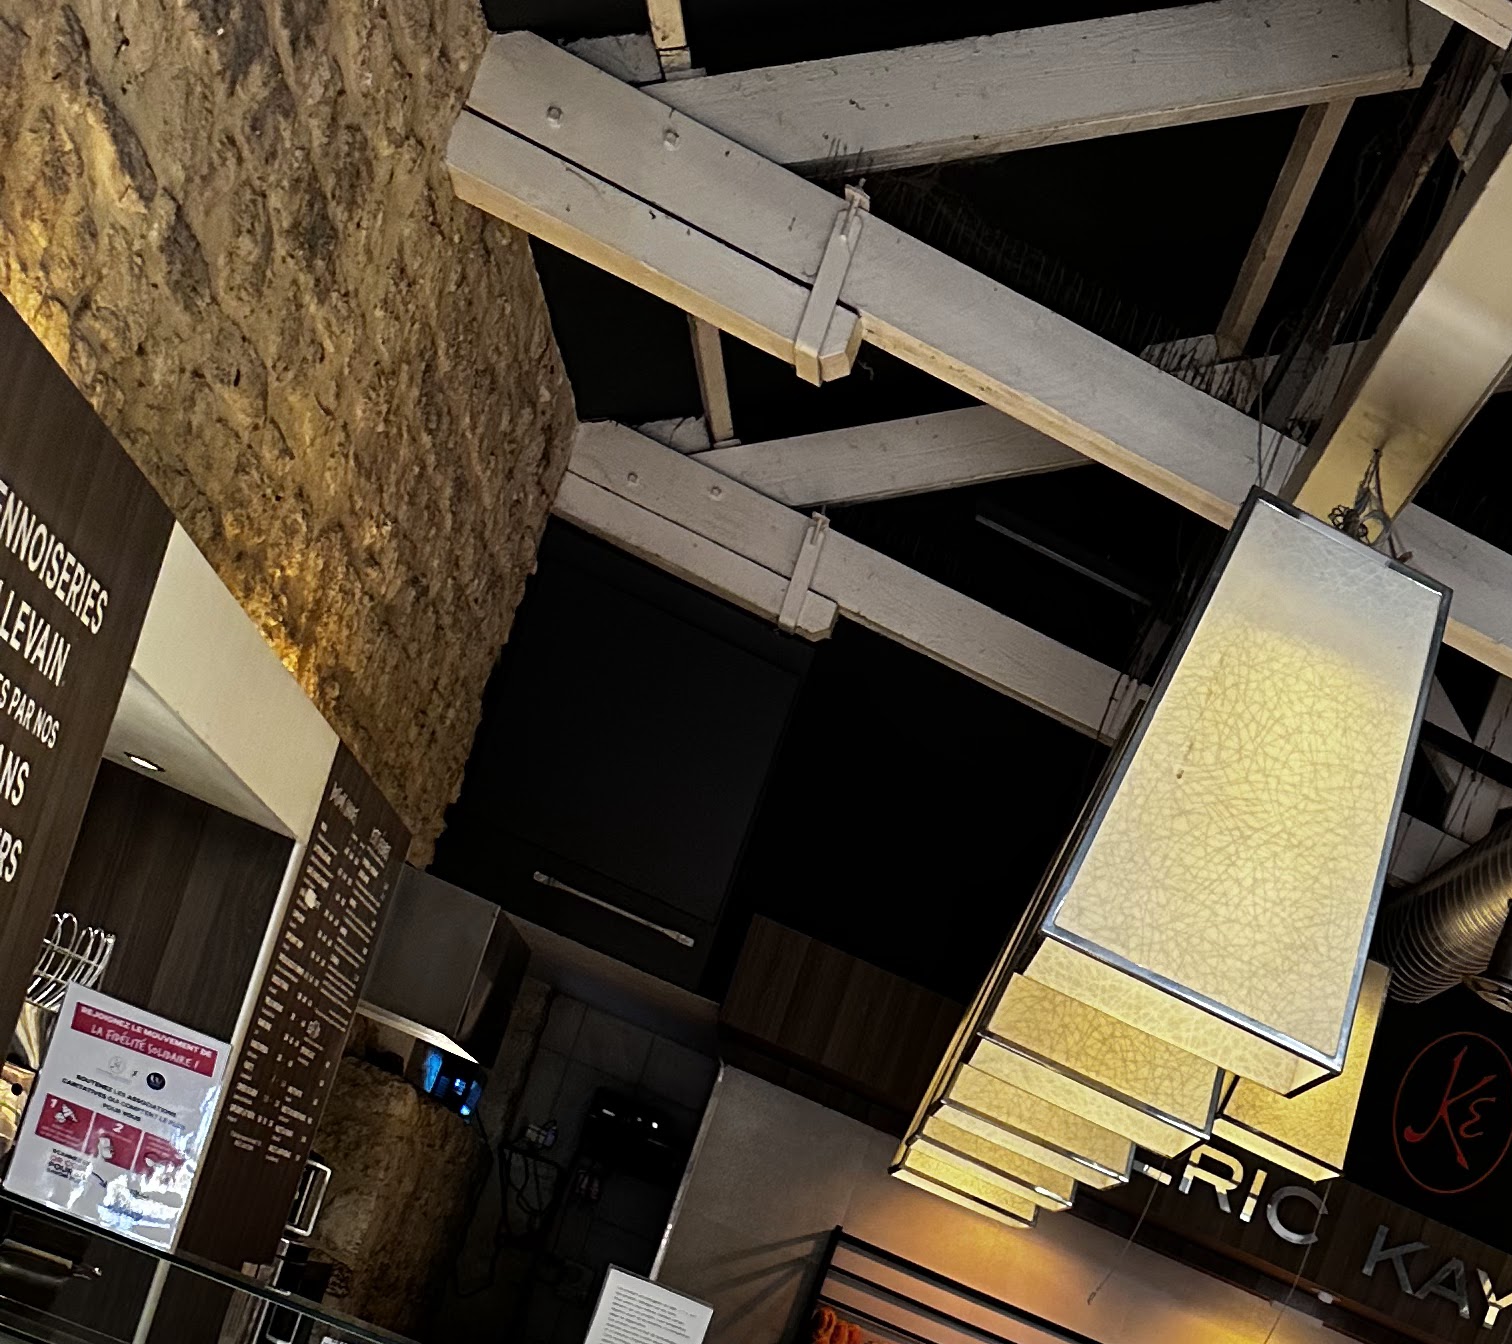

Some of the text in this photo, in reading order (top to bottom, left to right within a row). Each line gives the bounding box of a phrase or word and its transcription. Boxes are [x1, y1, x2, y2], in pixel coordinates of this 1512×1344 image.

[0, 589, 71, 687] LEVAIN
[7, 686, 35, 730] PAR
[32, 707, 59, 749] NOS
[80, 1006, 212, 1059] REJOIGNEZ LE MOUVEMENT DE
[91, 1024, 103, 1037] LA
[105, 1031, 147, 1051] FIDÉLITÉ
[148, 1043, 192, 1068] SOLIDAIRE
[113, 1122, 124, 1133] 2
